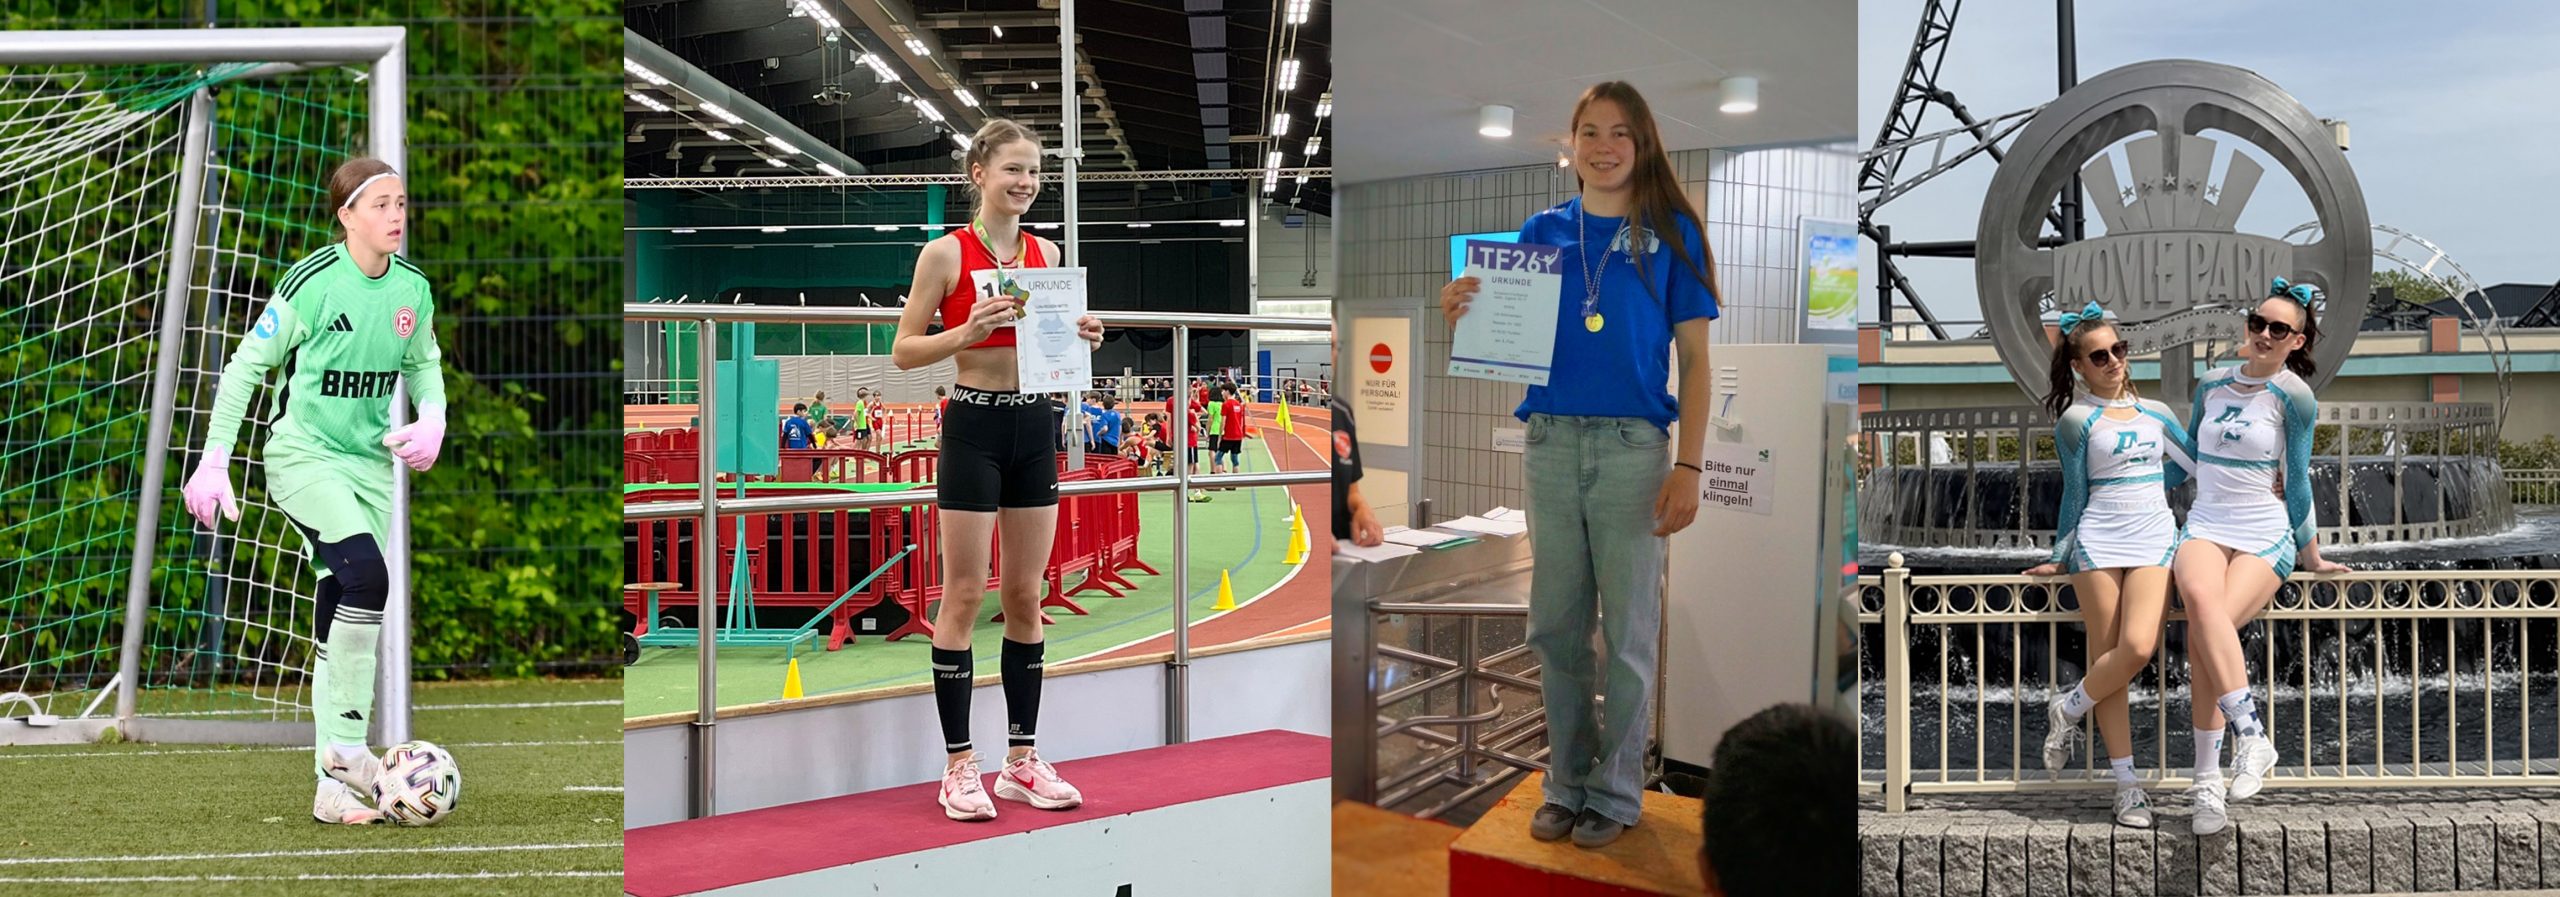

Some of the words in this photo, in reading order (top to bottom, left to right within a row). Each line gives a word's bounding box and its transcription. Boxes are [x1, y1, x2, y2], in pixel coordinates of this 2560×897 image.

[1467, 246, 1541, 273] LTF26
[2061, 237, 2174, 306] MOVIE
[2187, 237, 2287, 303] PARK
[1028, 280, 1072, 290] URKUNDE
[1491, 276, 1533, 287] URKUNDE
[320, 369, 400, 398] BRATA
[1365, 380, 1380, 388] NUR
[1382, 379, 1396, 388] FÜR
[953, 388, 992, 406] NIKE
[994, 393, 1037, 407] PRO
[1360, 389, 1401, 399] PERSONAL!
[1705, 460, 1732, 474] Bitte
[1735, 465, 1756, 477] nur
[1709, 477, 1748, 491] einmal
[1702, 490, 1753, 507] klingeln!
